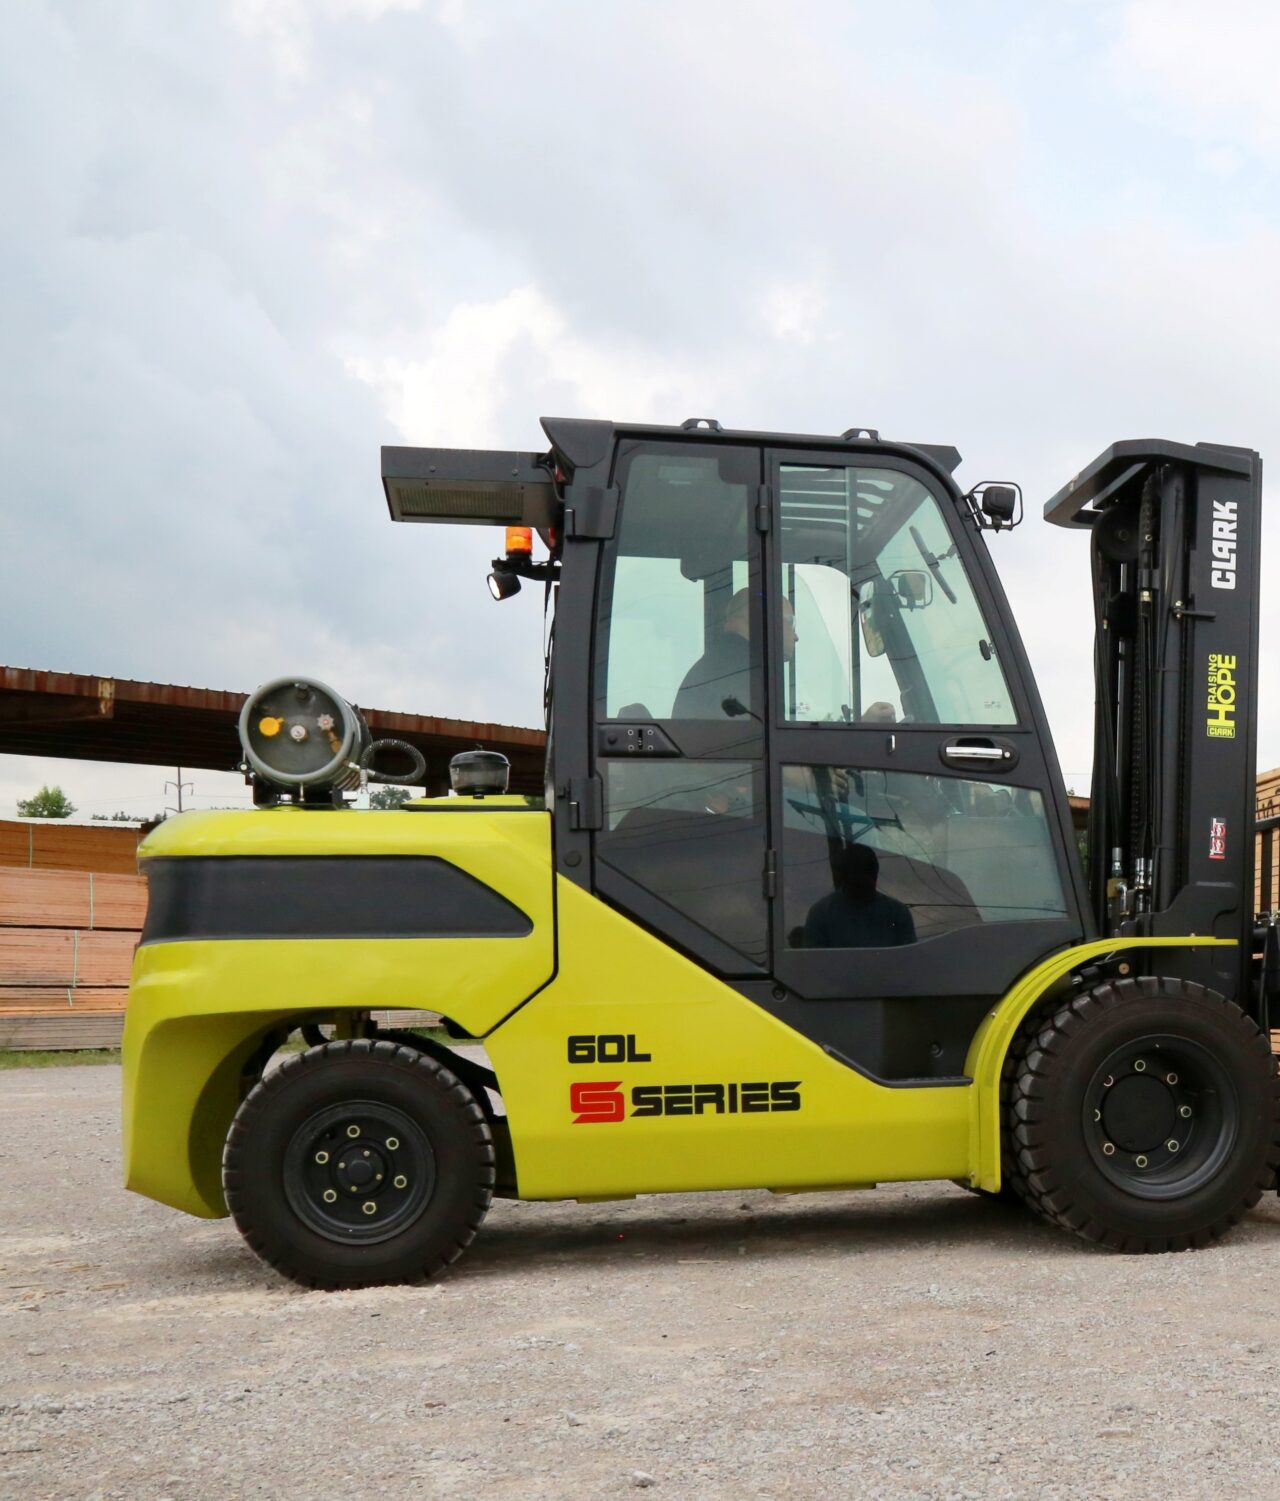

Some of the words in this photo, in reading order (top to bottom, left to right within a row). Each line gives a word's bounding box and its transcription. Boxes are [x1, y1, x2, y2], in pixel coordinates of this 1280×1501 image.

[1211, 500, 1238, 590] CLARK
[1207, 654, 1236, 726] HOPE
[1208, 654, 1217, 702] RAISING
[1209, 728, 1233, 736] CLARK
[567, 1034, 652, 1064] 60L
[569, 1081, 625, 1124] S
[629, 1081, 803, 1117] SERIES
